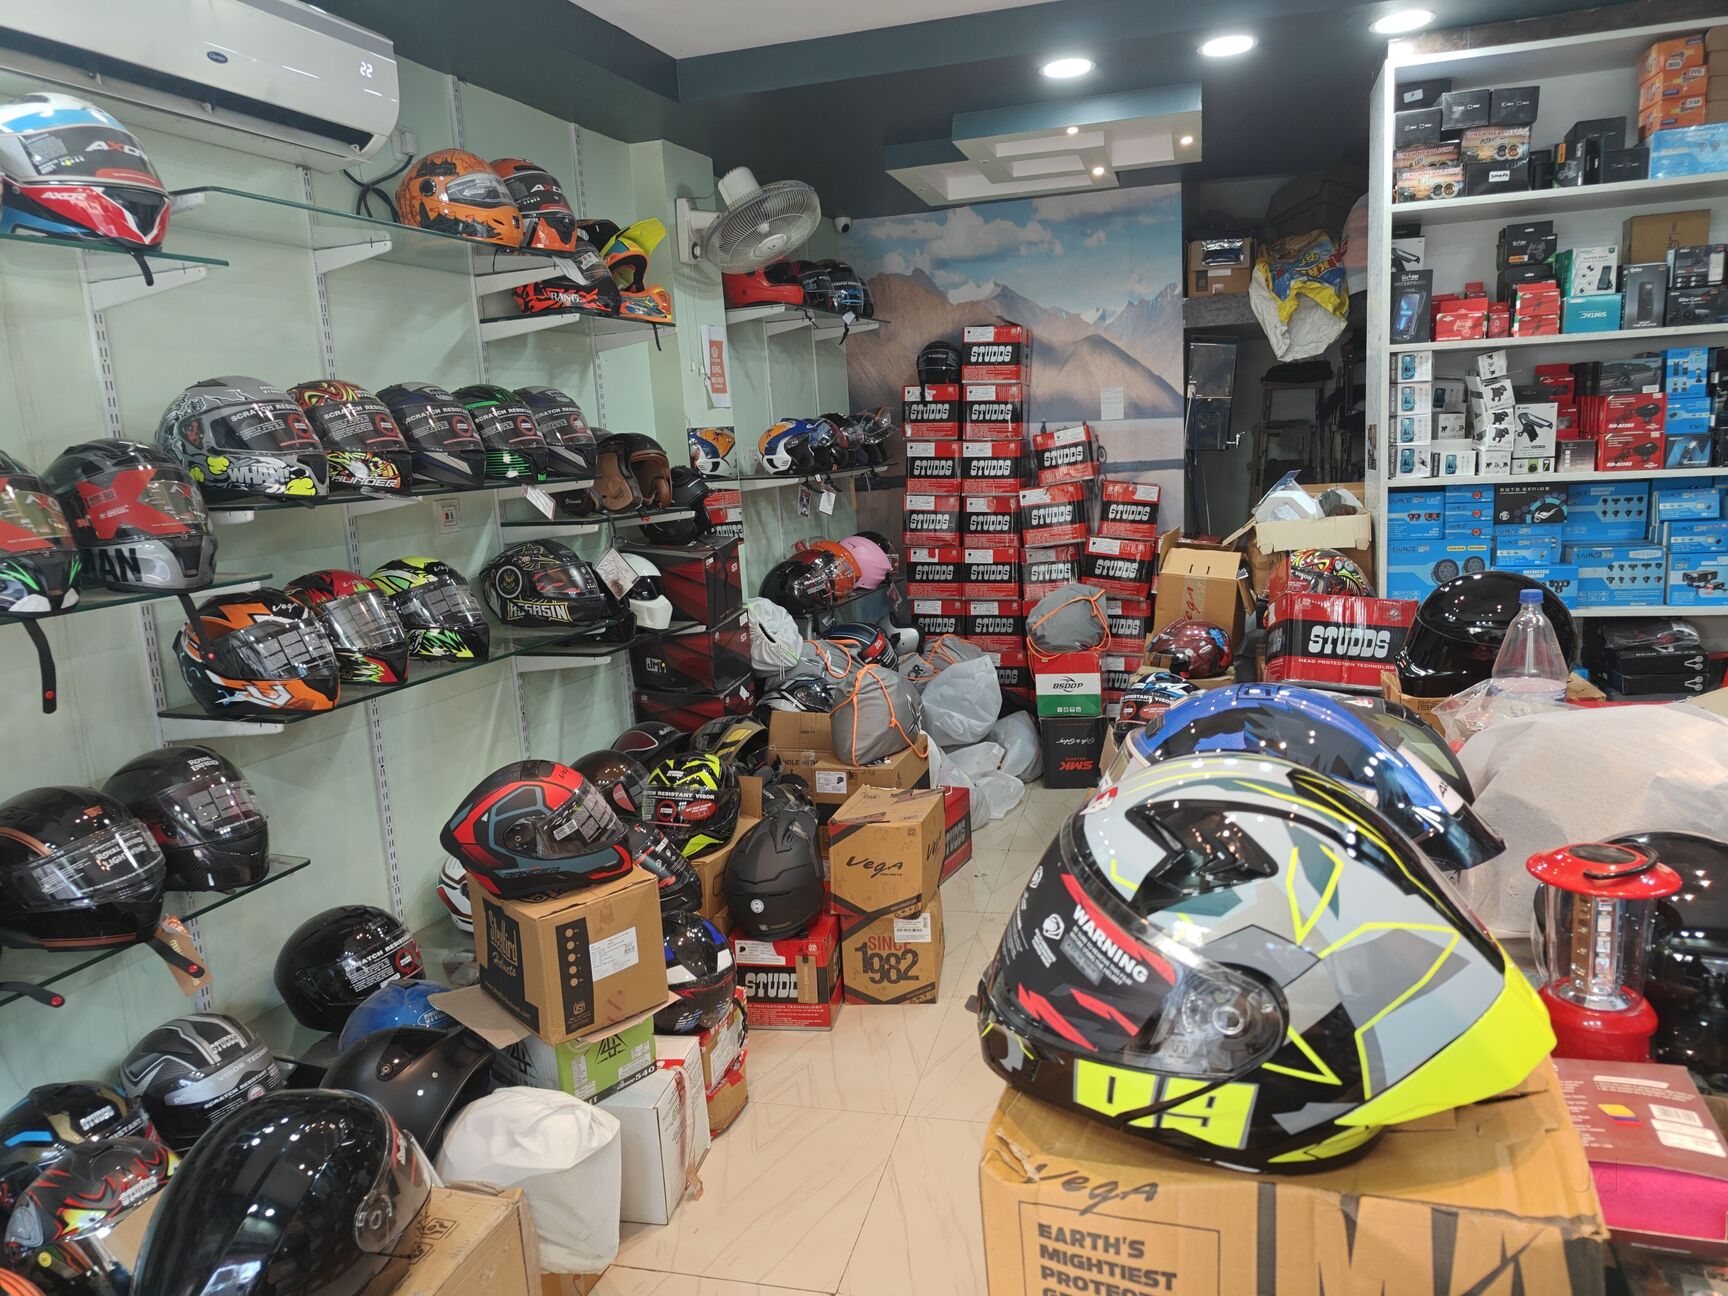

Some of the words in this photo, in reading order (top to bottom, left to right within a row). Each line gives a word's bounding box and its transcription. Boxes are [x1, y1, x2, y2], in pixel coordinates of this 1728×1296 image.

[970, 345, 1012, 362] STUDDS
[910, 403, 949, 419] STUDDS
[971, 403, 1012, 420] STUDDS
[1044, 446, 1083, 467] STUDDS
[914, 460, 953, 476] STUDDS
[970, 460, 1011, 476] STUDDS
[1031, 505, 1073, 526] STUDDS
[1109, 504, 1151, 521] STUDDS
[910, 514, 949, 529] STUDDS
[970, 515, 1010, 531] STUDDS
[915, 565, 954, 580] STUDDS
[971, 565, 1011, 580] STUDDS
[1031, 563, 1072, 581] STUDDS
[1094, 559, 1139, 579] STUDDS
[918, 618, 956, 633] STUDDS
[975, 618, 1014, 633] STUDDS
[1308, 625, 1391, 658] STUDDS
[1059, 760, 1093, 771] SMK
[1073, 904, 1149, 983] WARNING
[855, 942, 919, 985] 1982
[745, 972, 798, 998] STUDD
[634, 1065, 656, 1083] 540
[203, 1088, 239, 1109] SCRATCH
[1037, 1221, 1145, 1260] EARTH'S
[1038, 1243, 1178, 1291] MIGHTIEST
